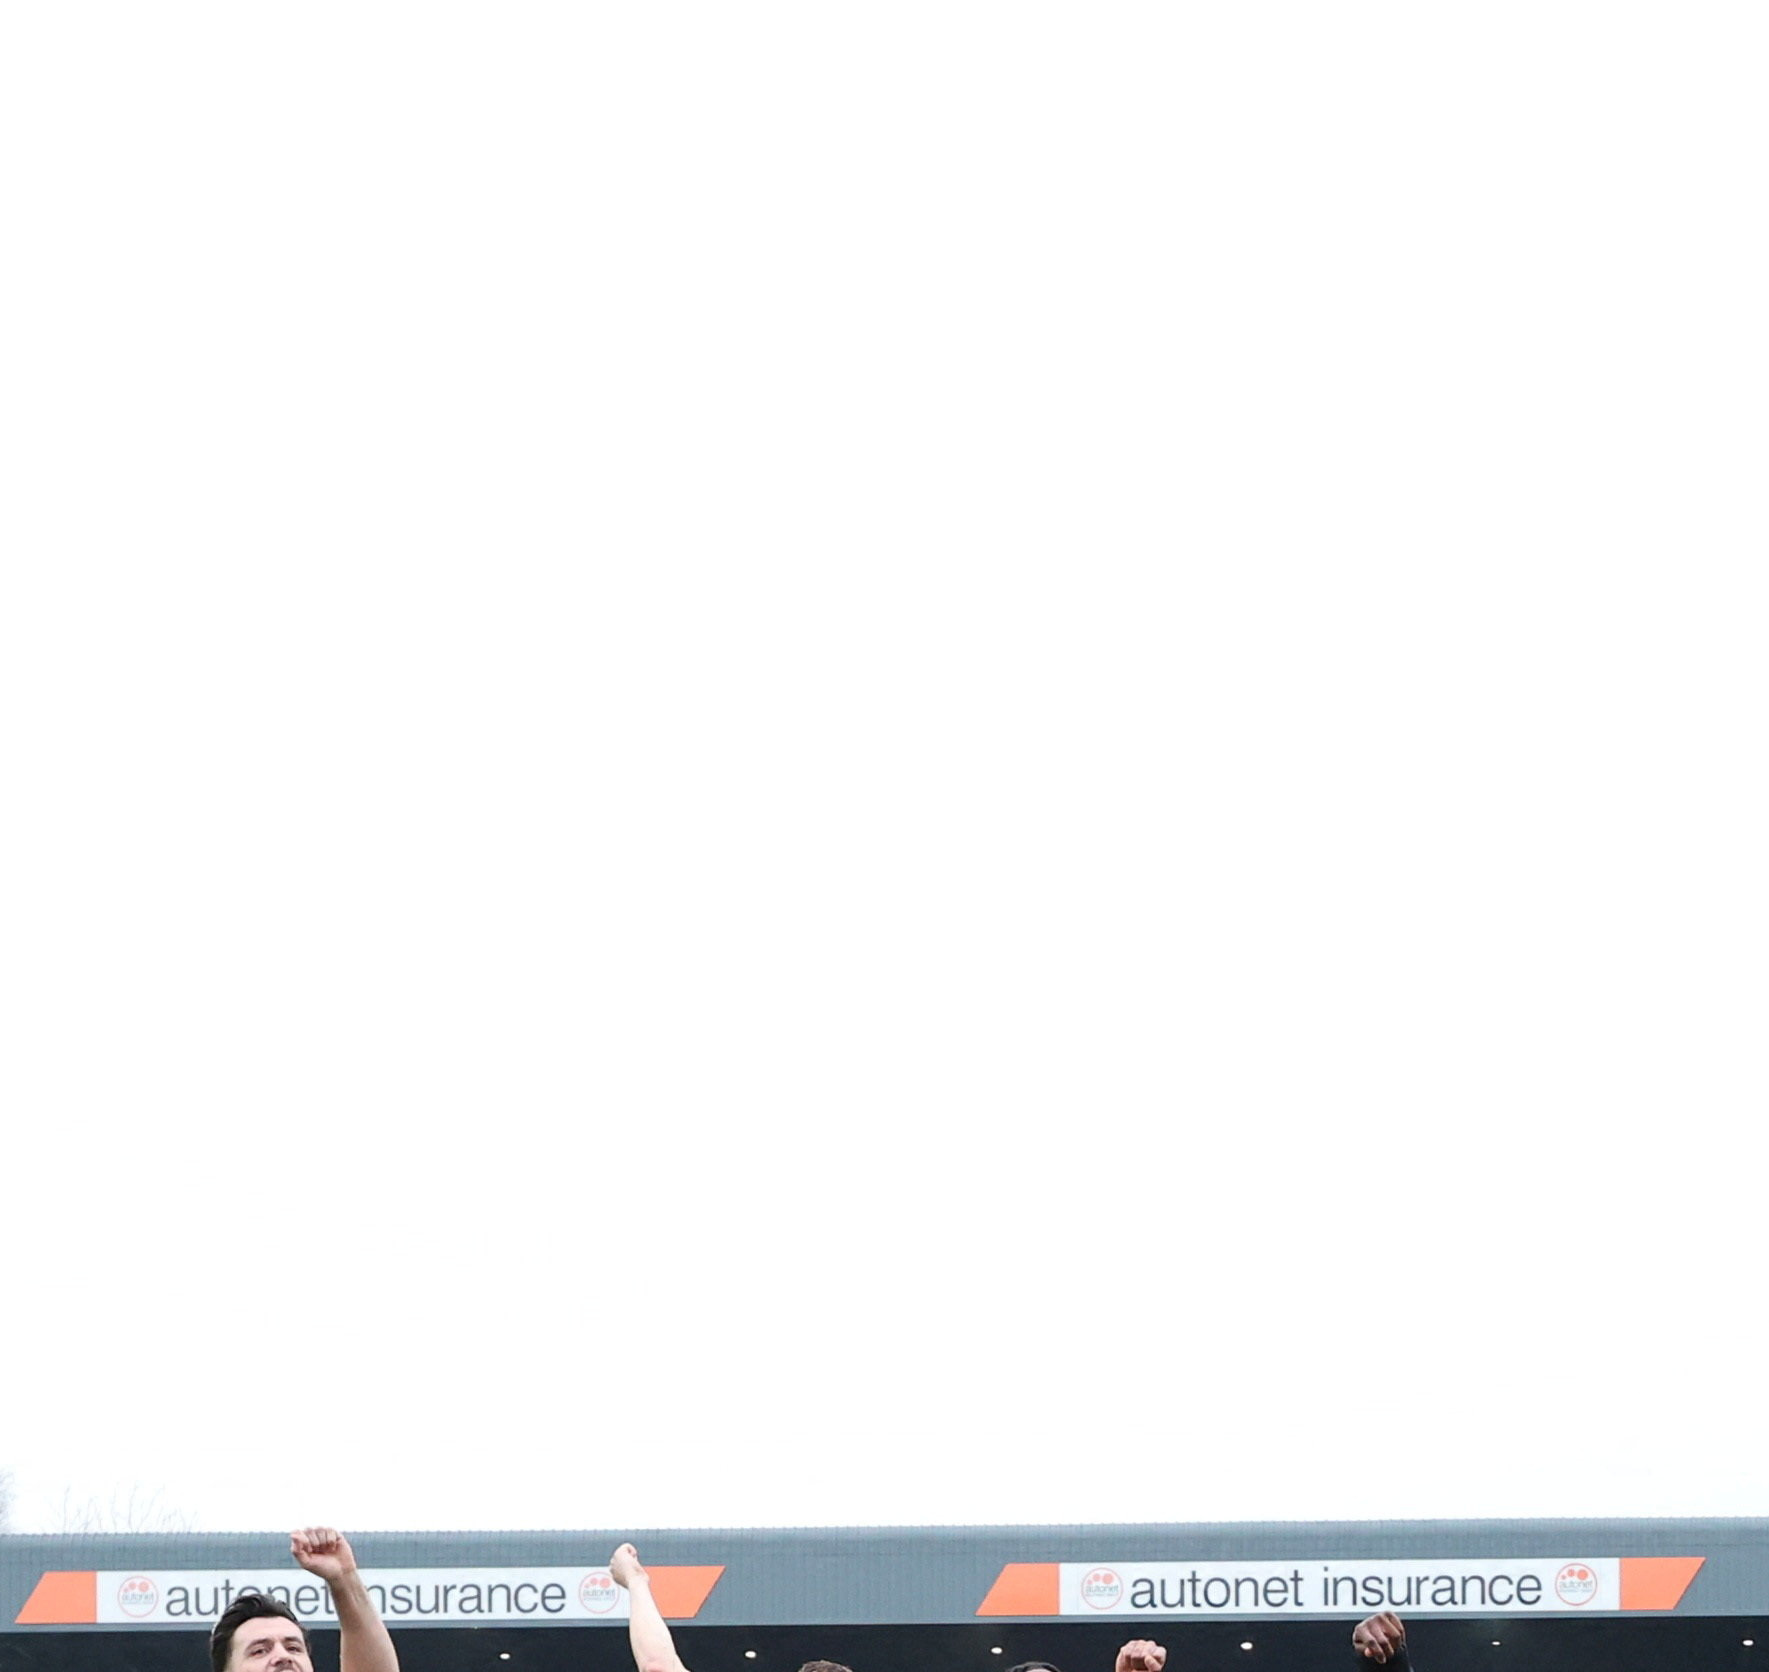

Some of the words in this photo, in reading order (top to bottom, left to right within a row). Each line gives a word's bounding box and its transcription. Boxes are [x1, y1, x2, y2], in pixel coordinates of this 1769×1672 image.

[166, 1578, 337, 1616] autnet
[364, 1582, 567, 1615] nsurance
[1131, 1569, 1304, 1609] autonet
[1323, 1566, 1542, 1607] insurance
